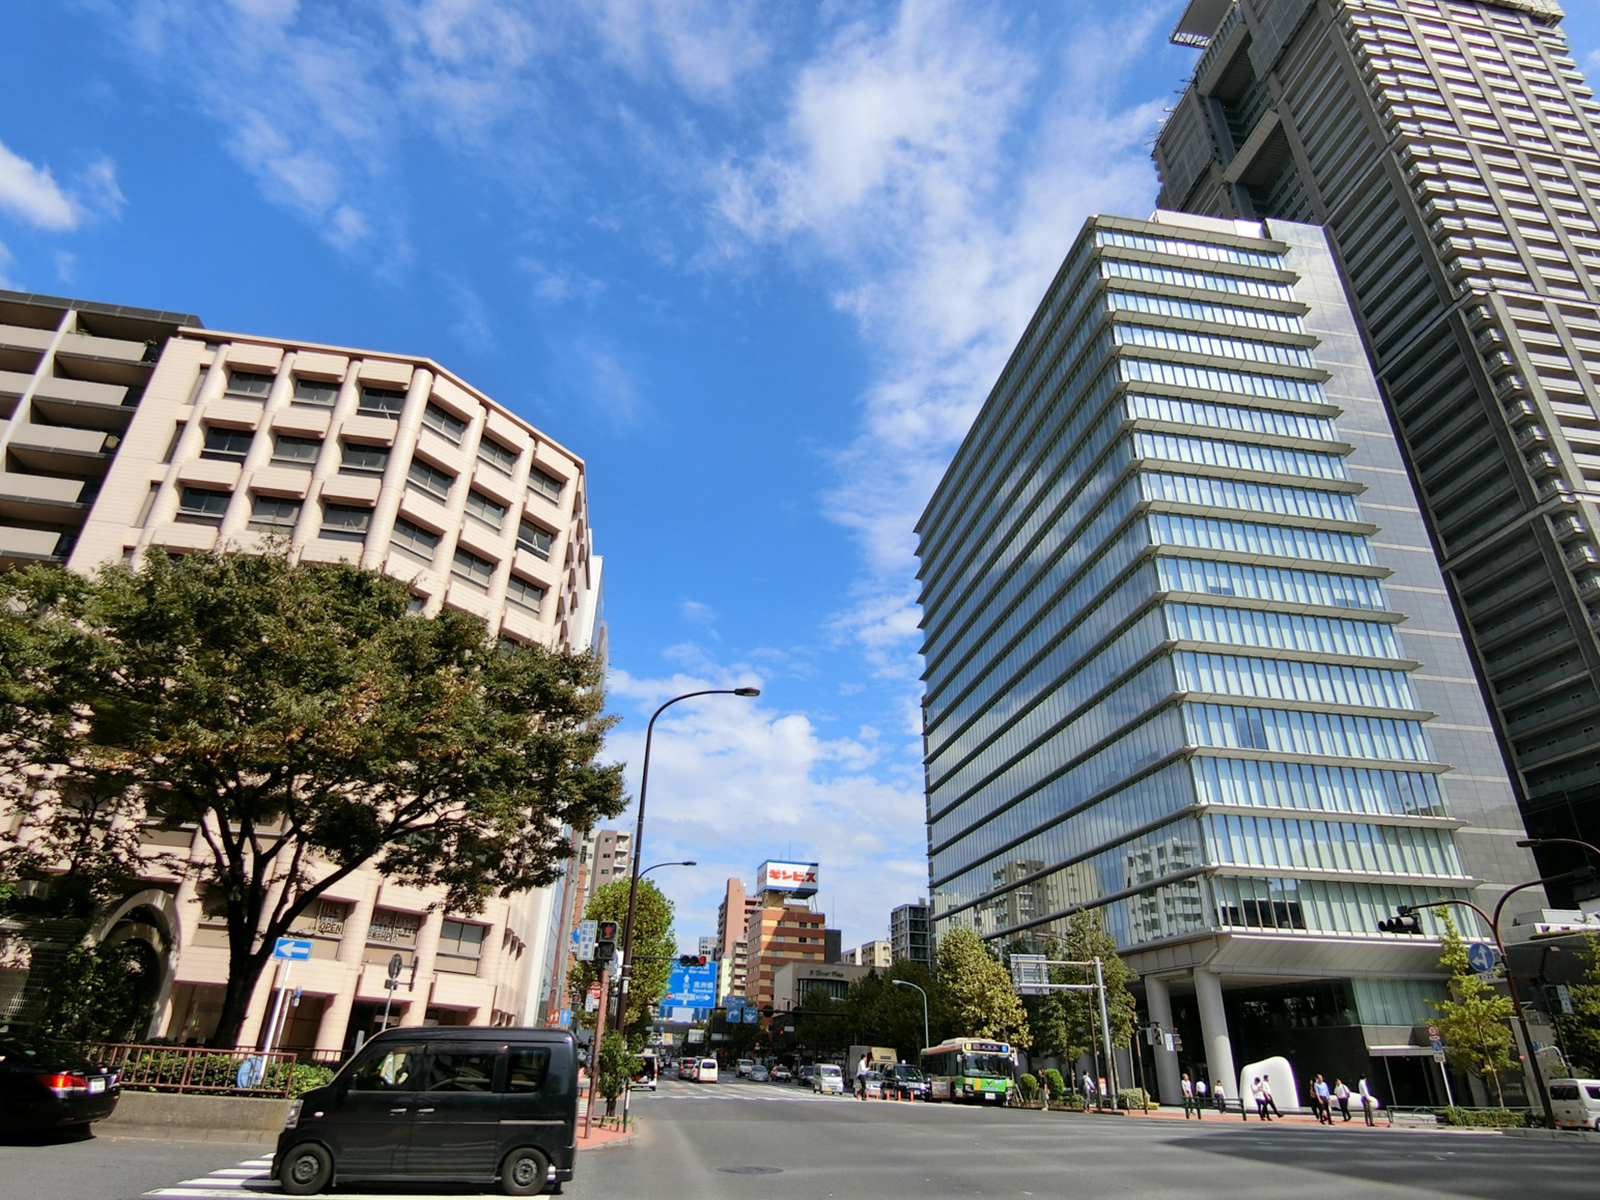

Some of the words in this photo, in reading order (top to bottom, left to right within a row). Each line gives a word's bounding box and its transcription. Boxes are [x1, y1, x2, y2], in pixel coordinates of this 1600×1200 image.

[769, 869, 816, 882] ギンビス
[319, 922, 341, 933] OPEN
